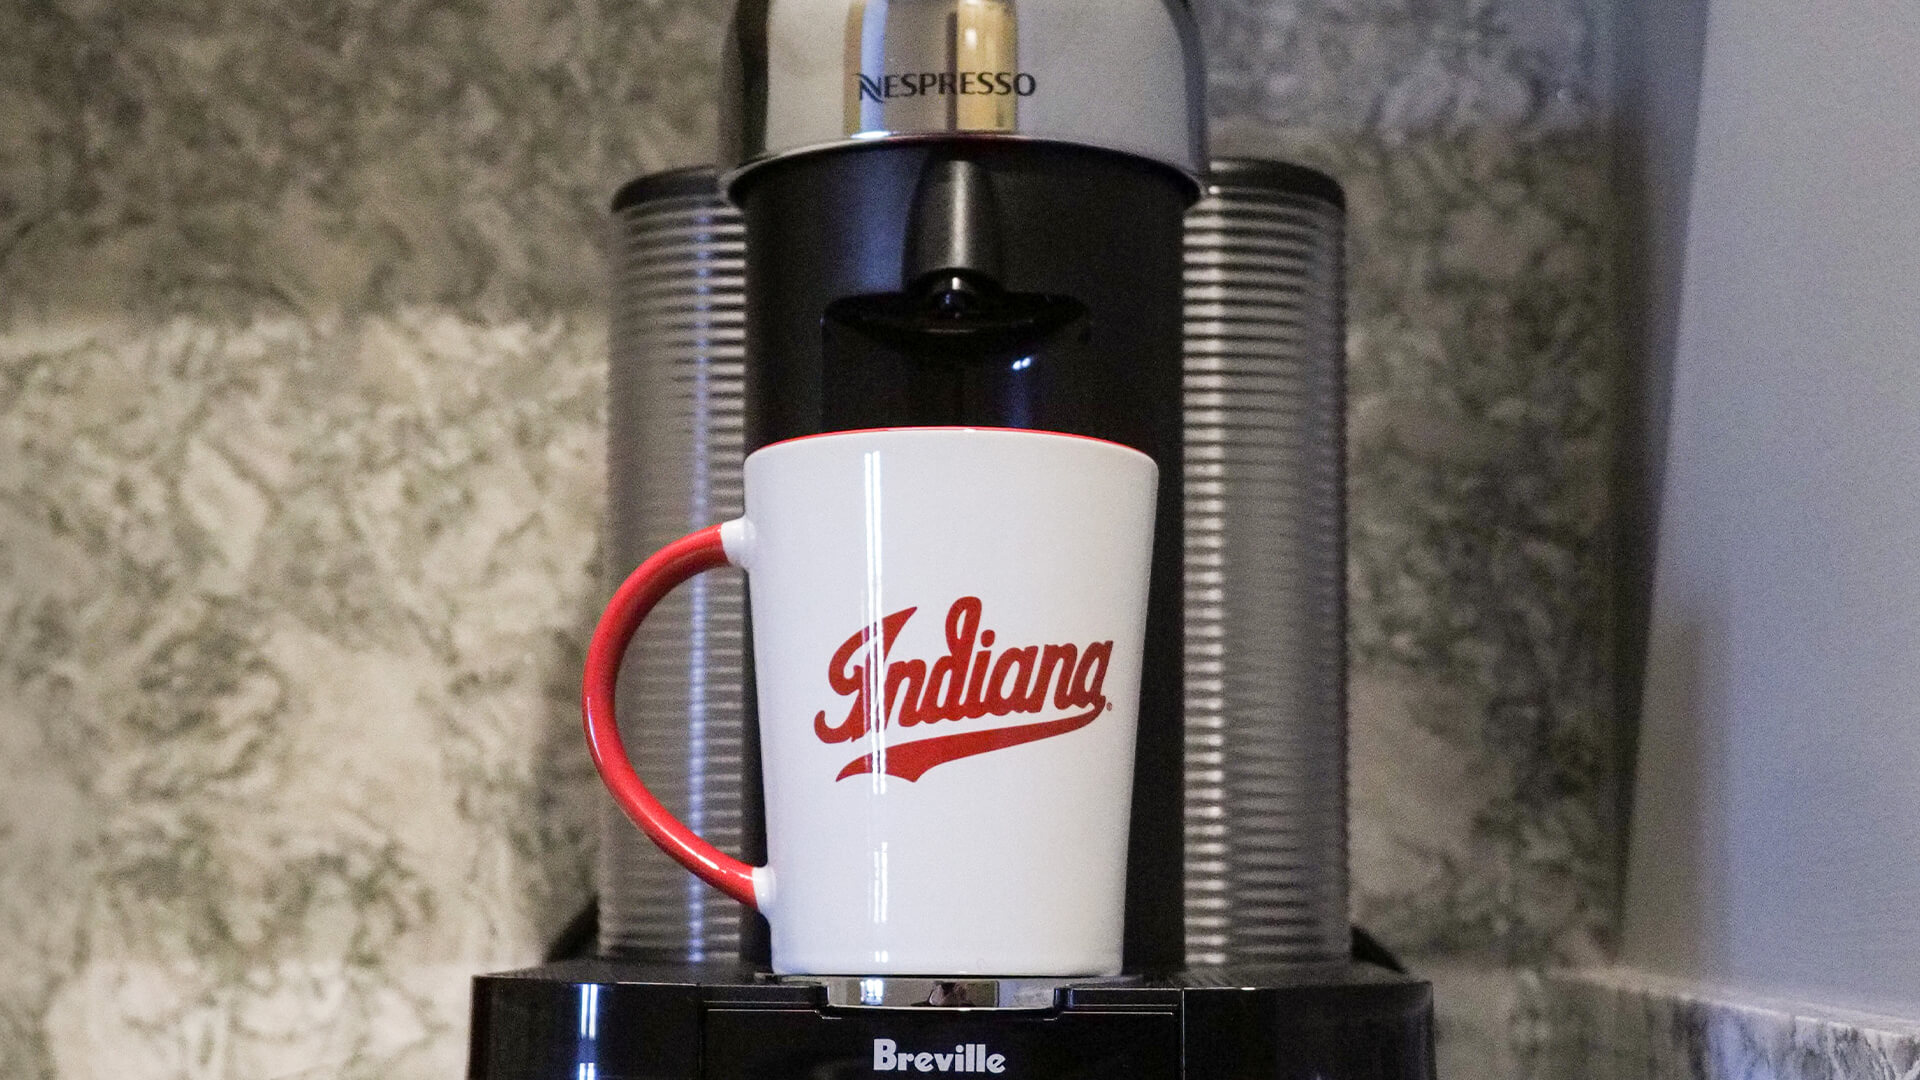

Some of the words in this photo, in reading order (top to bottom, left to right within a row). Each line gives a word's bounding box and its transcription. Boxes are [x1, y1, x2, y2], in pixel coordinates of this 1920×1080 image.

[857, 72, 1036, 103] NESPRESSO
[814, 596, 1114, 744] Indiana
[873, 1038, 1006, 1074] Breville
